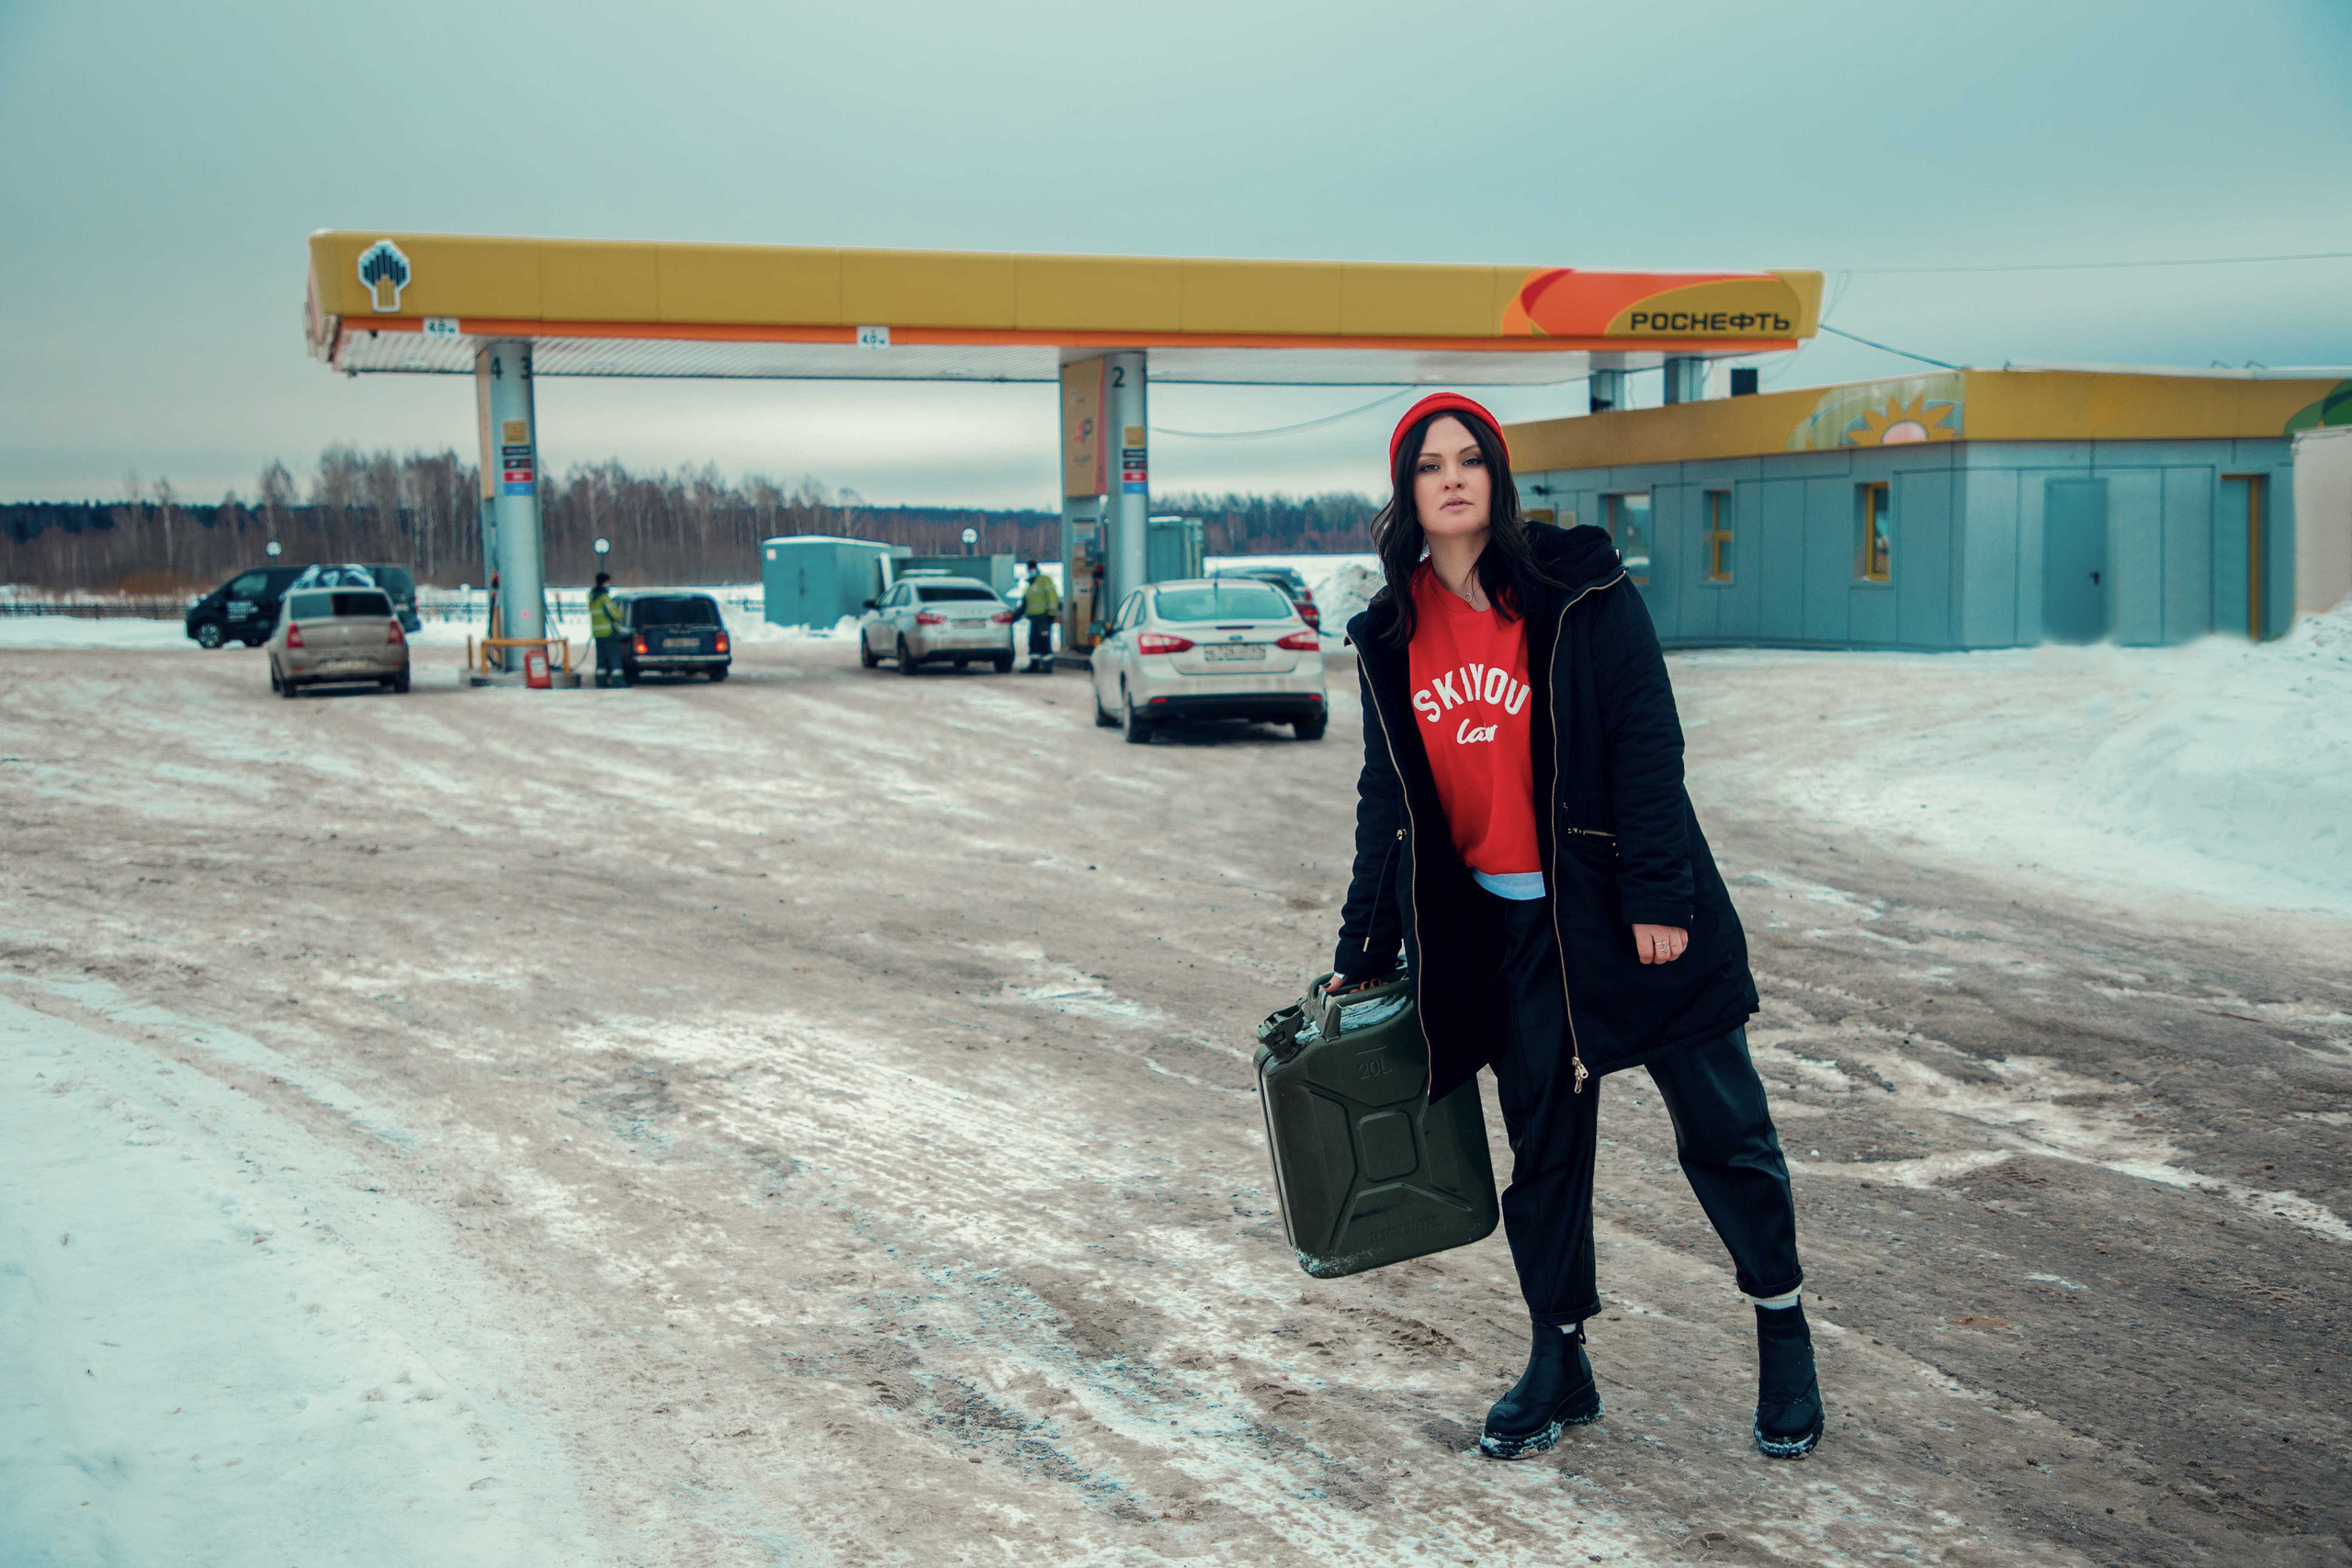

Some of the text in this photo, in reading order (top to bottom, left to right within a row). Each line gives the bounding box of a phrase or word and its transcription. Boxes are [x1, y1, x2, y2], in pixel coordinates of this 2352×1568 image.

[1630, 311, 1791, 333] РОСНЕФТЬ
[491, 355, 503, 381] 4
[519, 355, 531, 379] 3
[1112, 365, 1125, 389] 2
[1357, 1058, 1392, 1080] 20L
